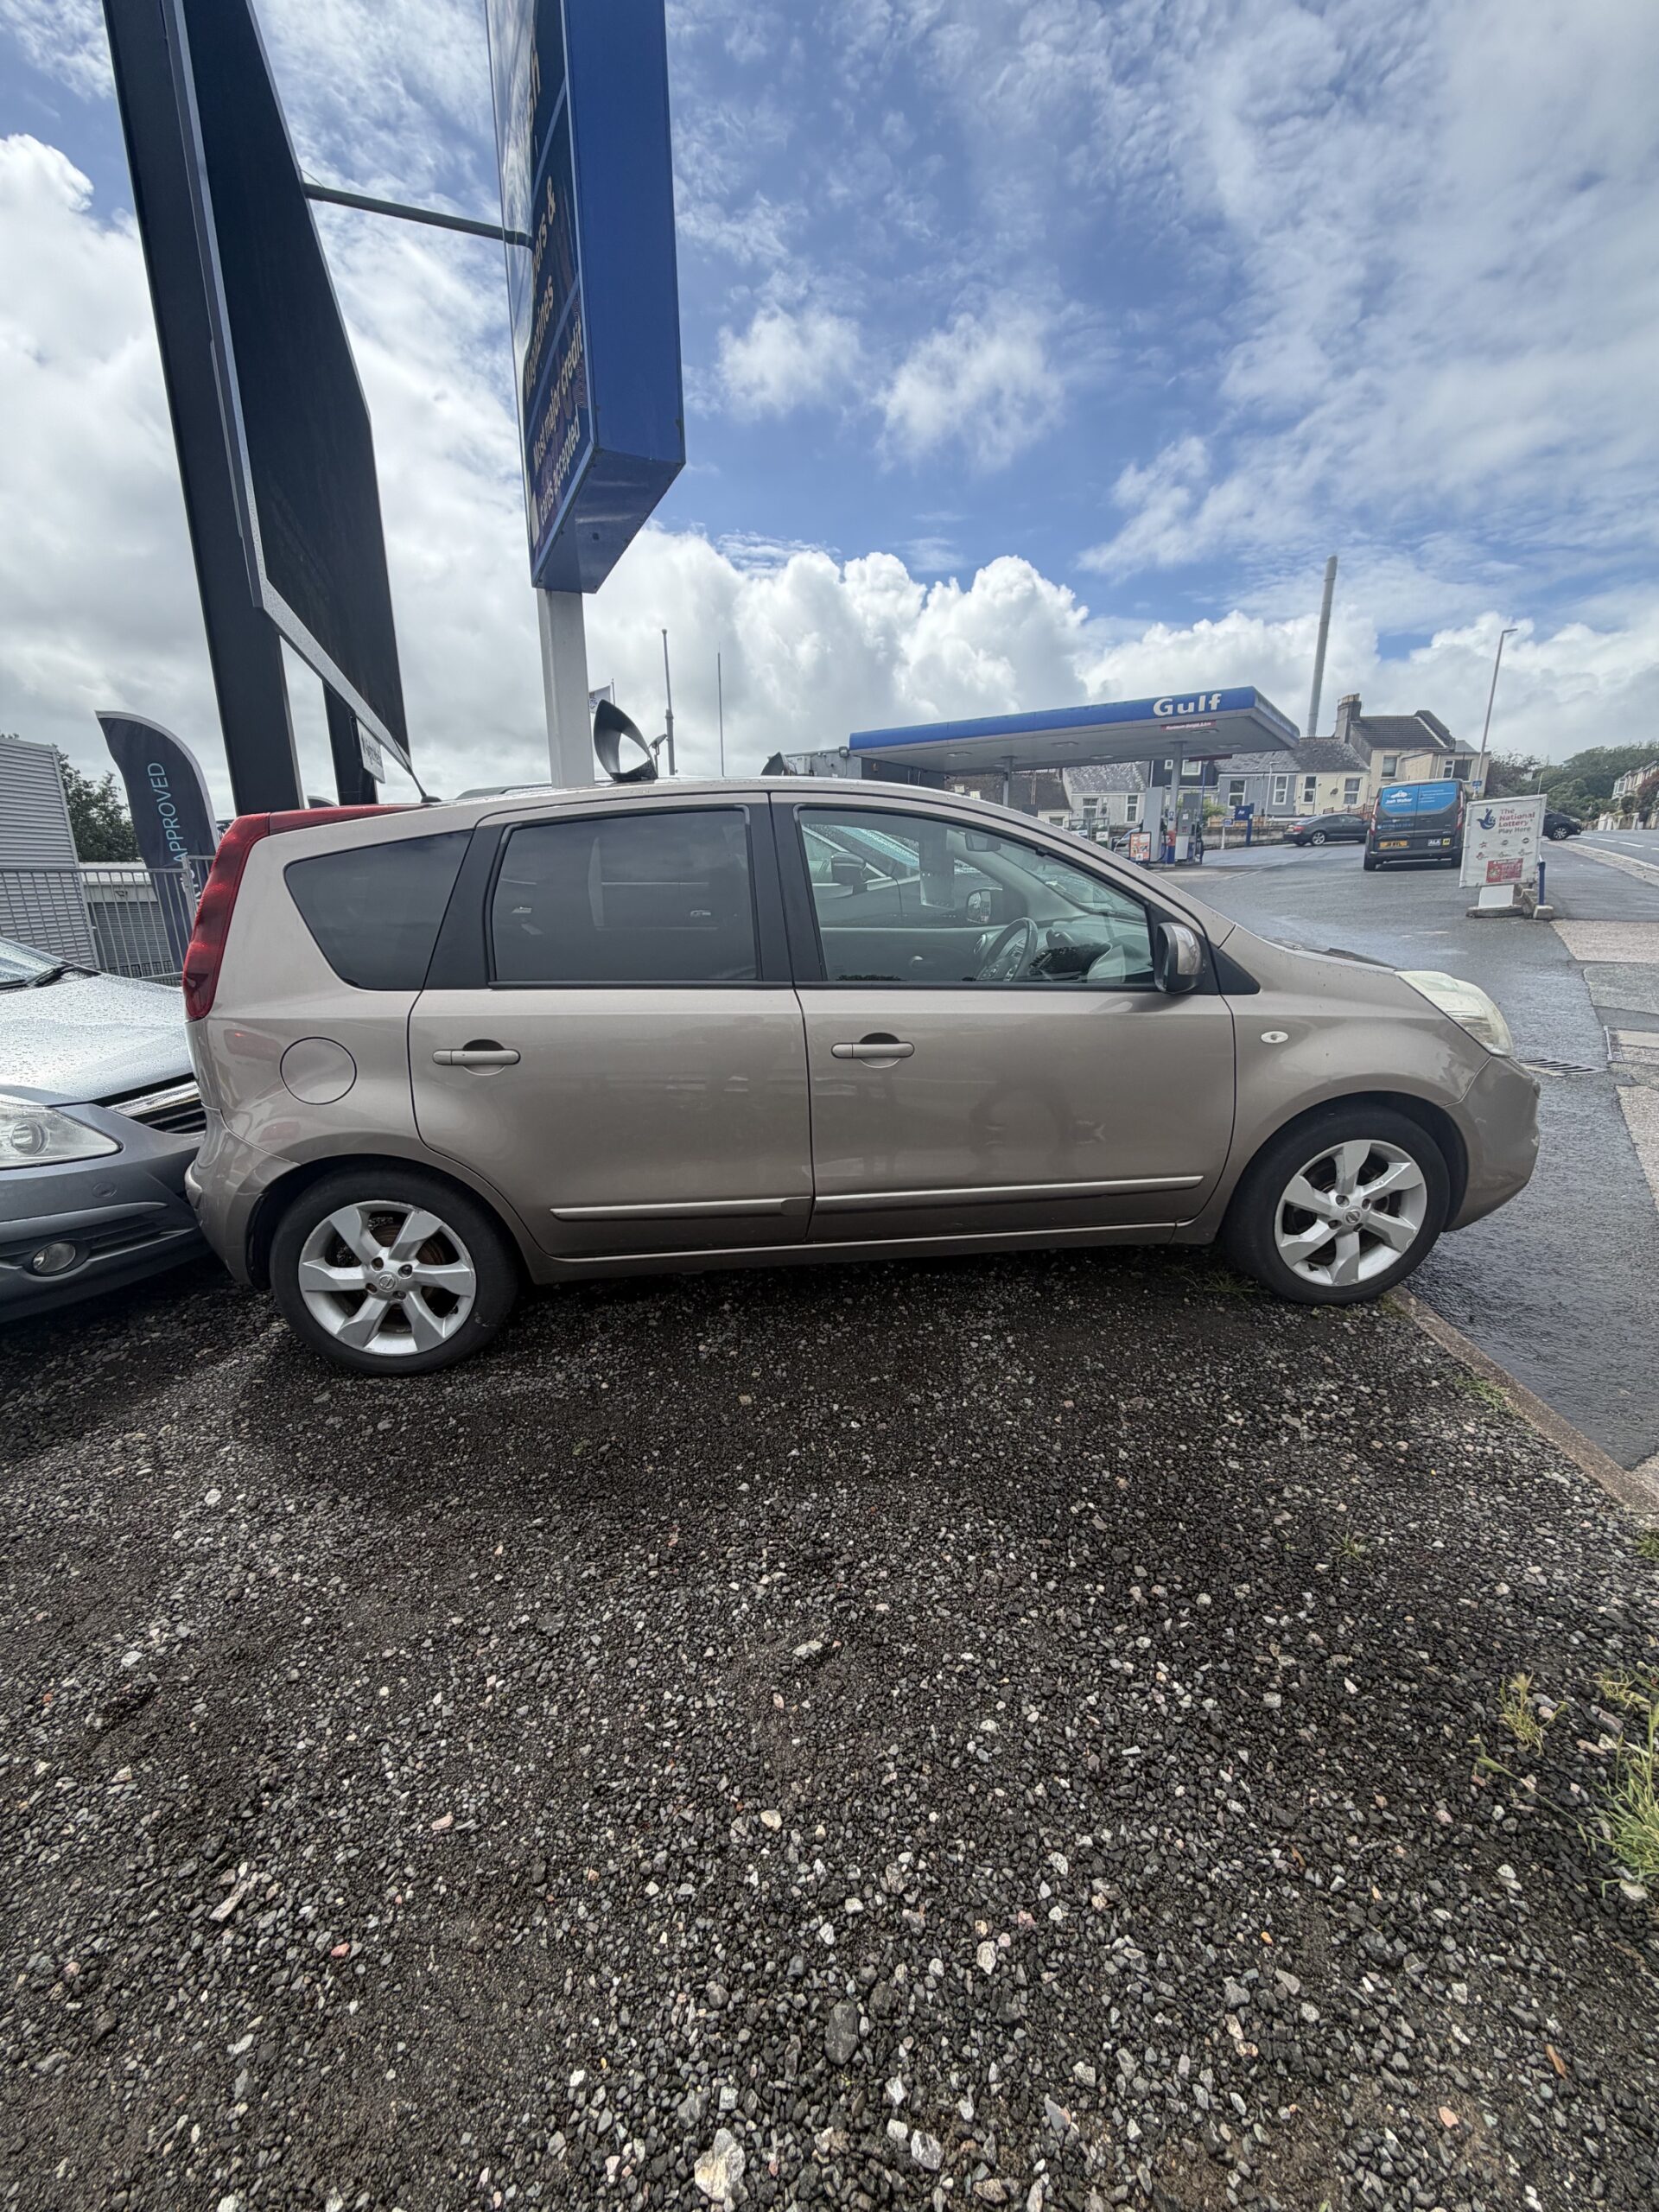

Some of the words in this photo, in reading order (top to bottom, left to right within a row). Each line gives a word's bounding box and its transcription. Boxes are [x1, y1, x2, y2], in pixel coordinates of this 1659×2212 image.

[547, 175, 556, 225] &
[543, 383, 561, 442] major
[561, 320, 583, 396] credit
[540, 477, 554, 526] cards
[553, 404, 580, 495] accepted
[1153, 693, 1222, 716] Gulf
[147, 762, 188, 863] APPROVED
[1499, 812, 1535, 821] National
